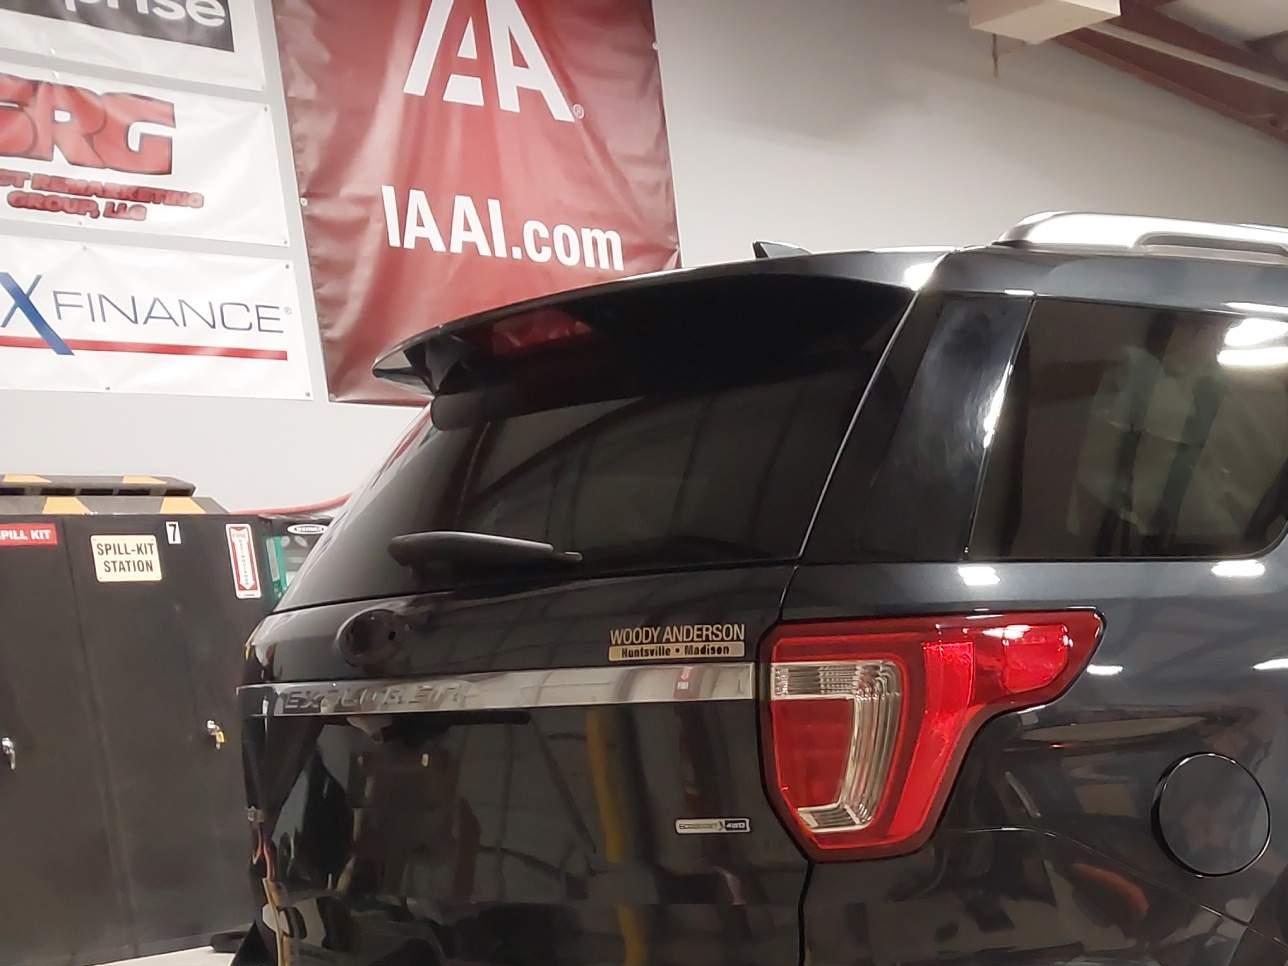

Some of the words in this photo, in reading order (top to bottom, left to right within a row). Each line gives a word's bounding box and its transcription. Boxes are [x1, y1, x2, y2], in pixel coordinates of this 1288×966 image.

[380, 184, 624, 271] IAAI.com
[30, 529, 51, 541] KIT
[168, 523, 177, 542] 7
[97, 541, 155, 557] SPILL-KIT
[103, 559, 154, 574] STATION
[610, 627, 660, 645] WOODY
[662, 624, 745, 642] ANDERSON
[621, 646, 671, 658] Huntsville
[684, 645, 729, 656] Madison
